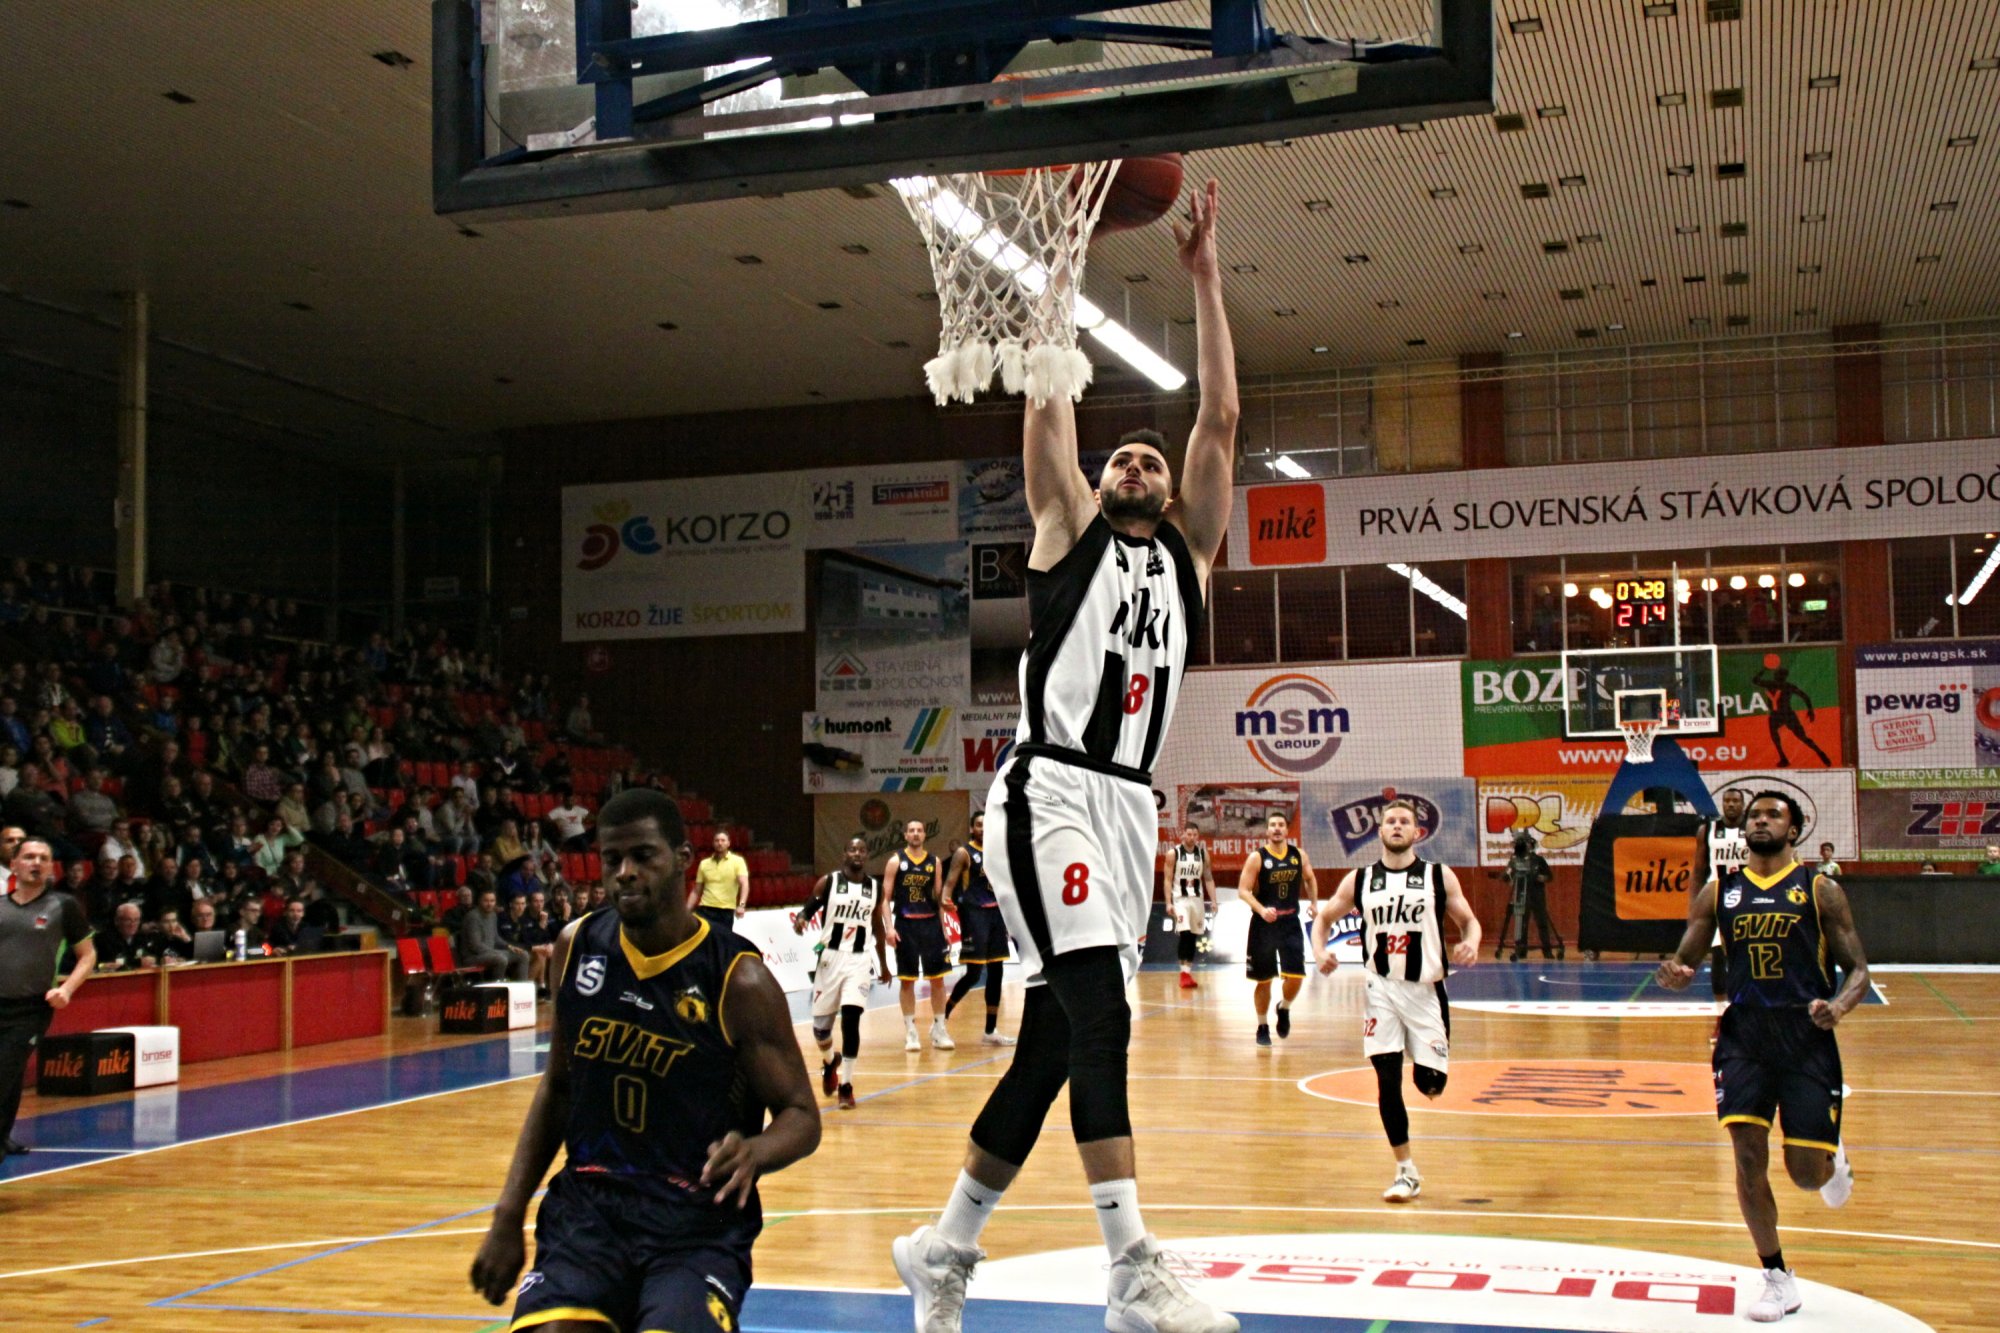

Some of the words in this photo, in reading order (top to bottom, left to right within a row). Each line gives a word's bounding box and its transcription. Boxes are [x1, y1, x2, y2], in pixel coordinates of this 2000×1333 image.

[1360, 497, 1443, 536] PRVÁ
[1453, 486, 1648, 532] SLOVENSKÁ
[1660, 474, 1853, 521] STÁVKOVÁ
[1258, 507, 1316, 541] niké
[1616, 581, 1665, 601] 07:28
[576, 608, 641, 630] KORZO
[648, 604, 683, 627] ŽIJE
[691, 601, 792, 625] ŠPORTOM
[1864, 648, 1988, 663] www.pewagsk.sk
[1122, 673, 1150, 715] 8
[1865, 692, 1961, 715] pewag
[825, 717, 892, 734] humont
[1236, 706, 1350, 737] msm
[1883, 719, 1922, 730] STRONG
[1274, 739, 1322, 751] GROUP
[1885, 734, 1926, 746] ENOUGH
[870, 764, 949, 775] www.humont.sk
[1944, 769, 1986, 780] DVERE
[1062, 862, 1090, 907] 8
[1625, 859, 1691, 894] niké
[834, 899, 871, 922] niké
[1371, 894, 1426, 926] niké
[844, 926, 857, 941] 7
[1733, 912, 1802, 942] SVIT
[1384, 934, 1411, 955] 32
[1748, 942, 1784, 980] 12
[813, 990, 822, 1003] 7
[444, 1000, 477, 1020] niké
[141, 1050, 173, 1063] brose
[574, 1016, 696, 1078] SVIT
[43, 1051, 85, 1078] niké
[96, 1048, 131, 1077] niké
[613, 1073, 647, 1134] 0
[1165, 1259, 1736, 1316] brose
